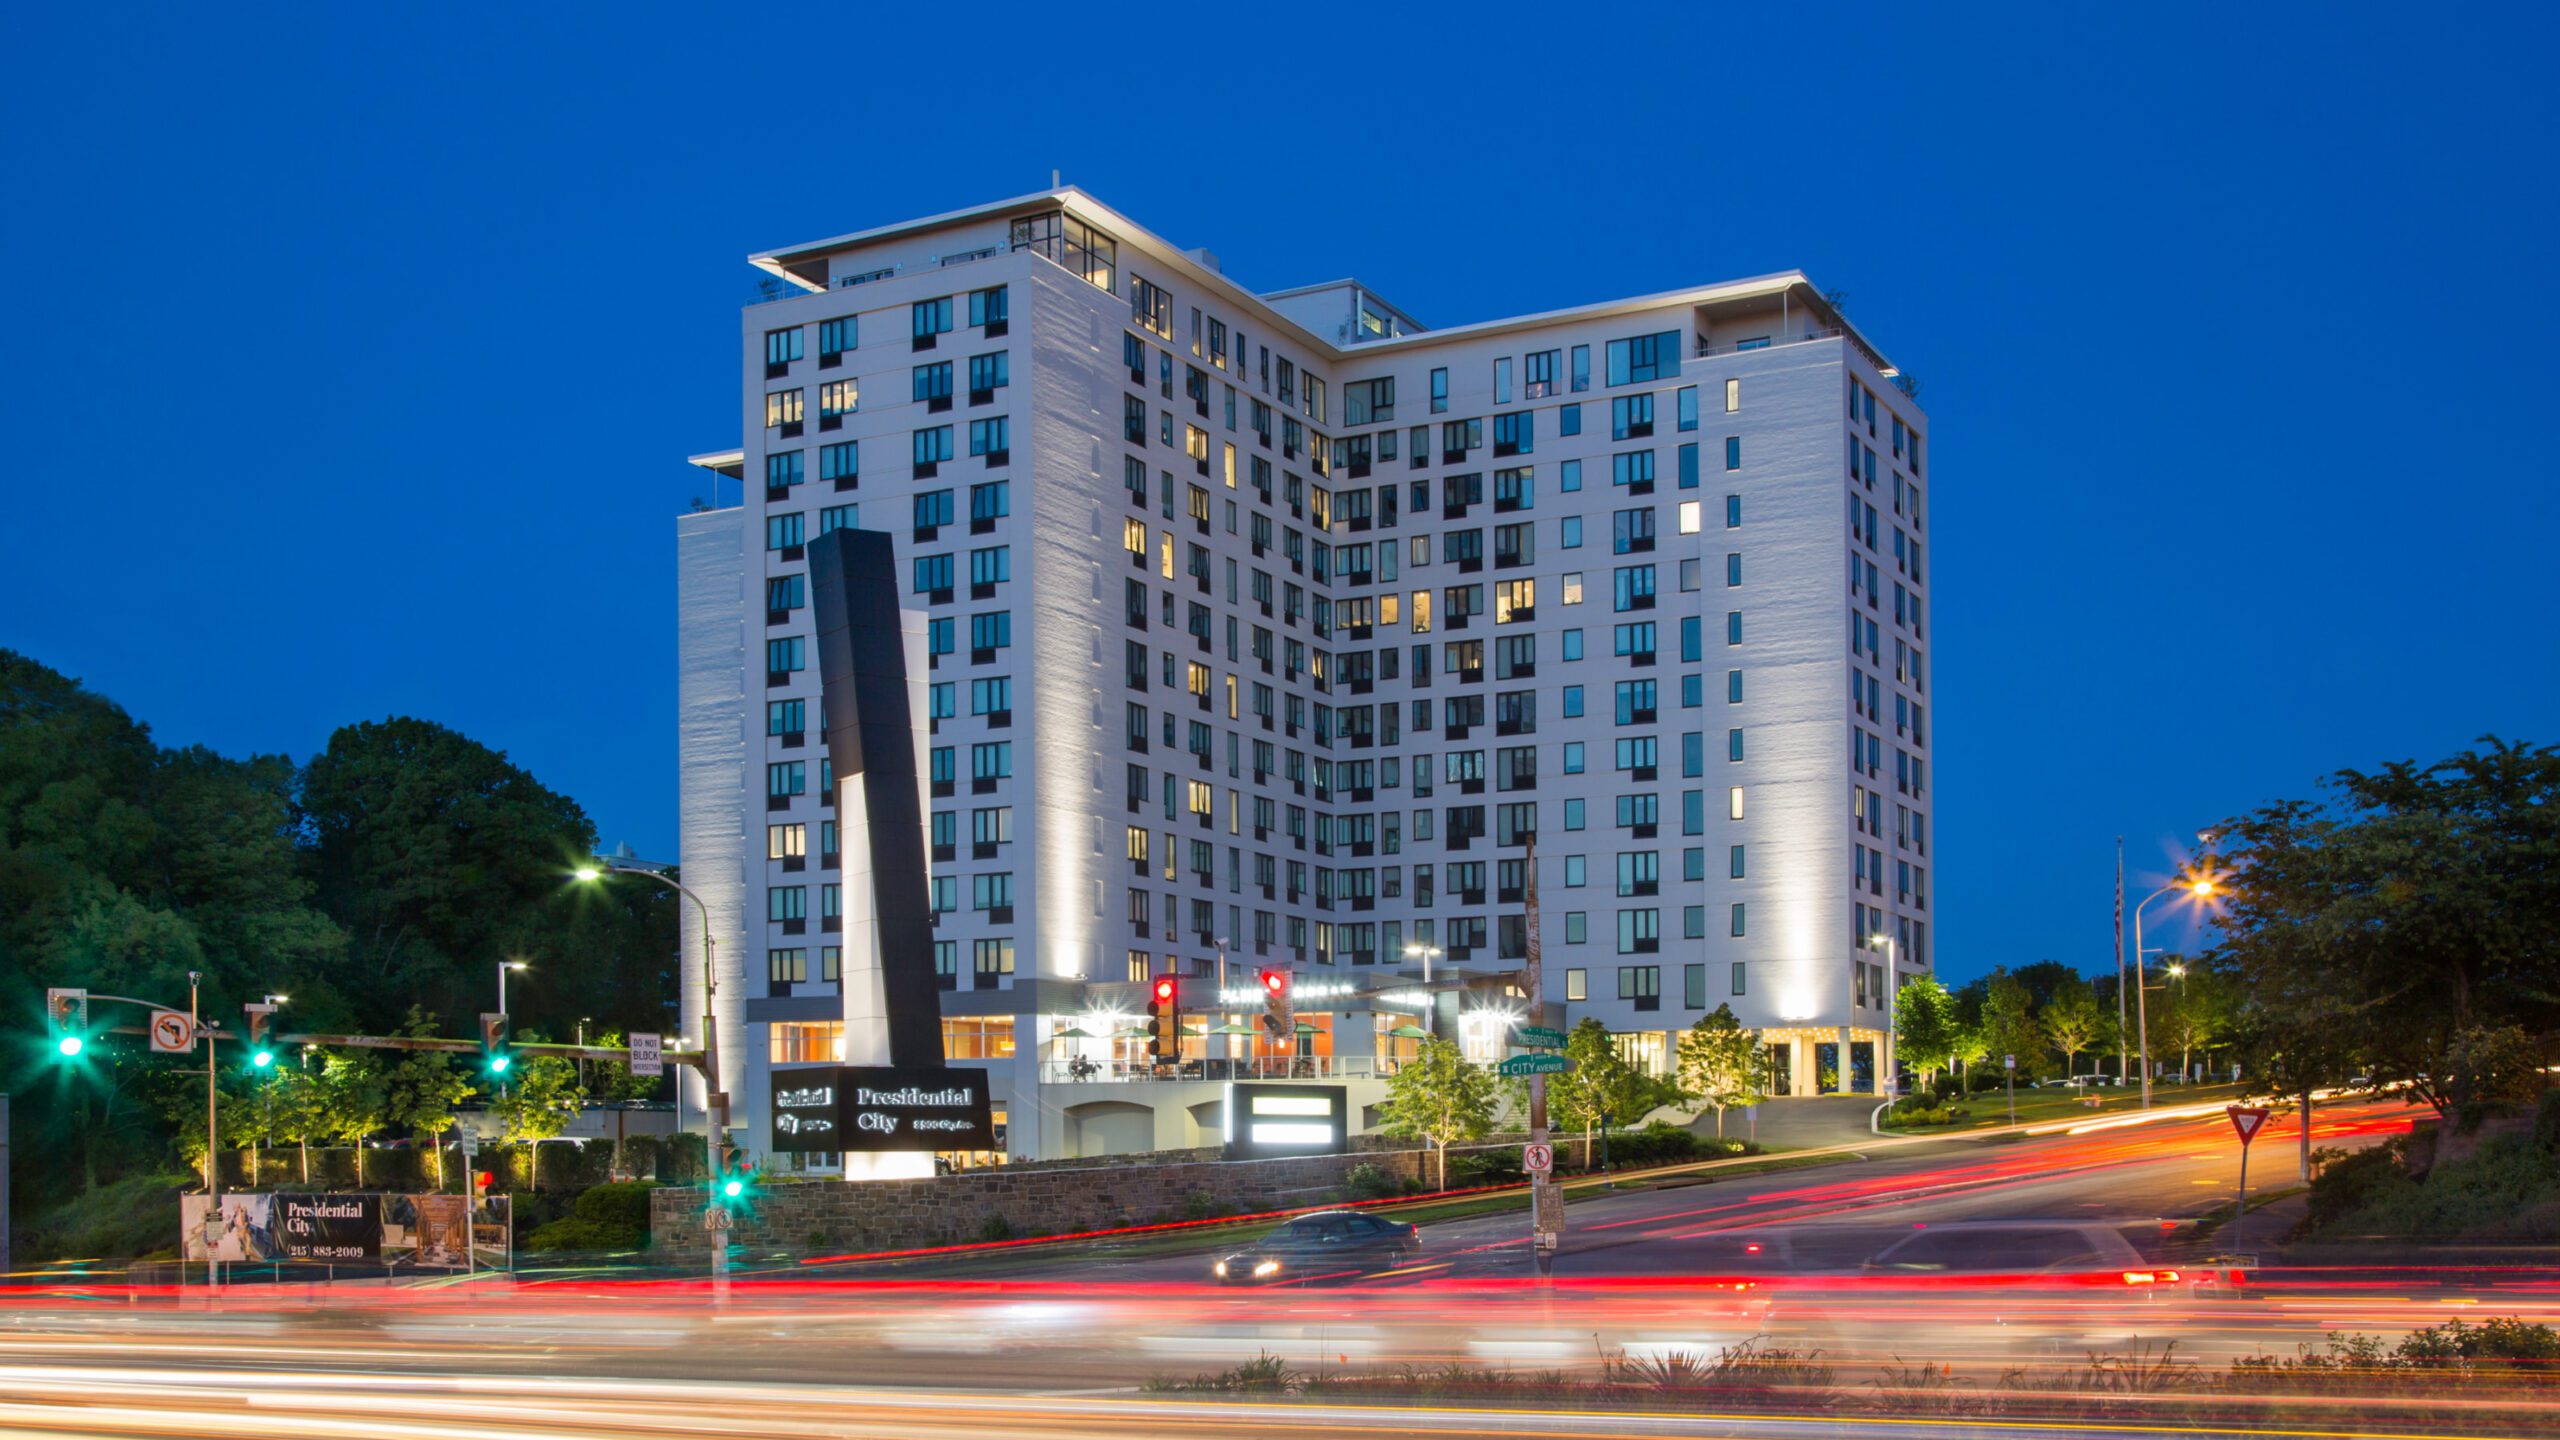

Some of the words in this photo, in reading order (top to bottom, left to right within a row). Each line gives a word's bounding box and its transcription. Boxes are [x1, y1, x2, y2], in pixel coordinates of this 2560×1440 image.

[633, 1038, 643, 1047] DO
[645, 1038, 657, 1047] NOT
[1518, 1033, 1561, 1048] PRESIDENTIAL
[633, 1050, 658, 1061] BLOCK
[633, 1063, 661, 1071] INTERSECTION
[1511, 1062, 1535, 1075] CITY
[1536, 1062, 1564, 1073] AVENUE
[857, 1088, 972, 1105] Presidential
[858, 1112, 899, 1134] City
[287, 1202, 363, 1218] Presidential
[287, 1217, 311, 1236] City
[286, 1244, 311, 1258] (215)
[313, 1245, 364, 1258] 883-2009
